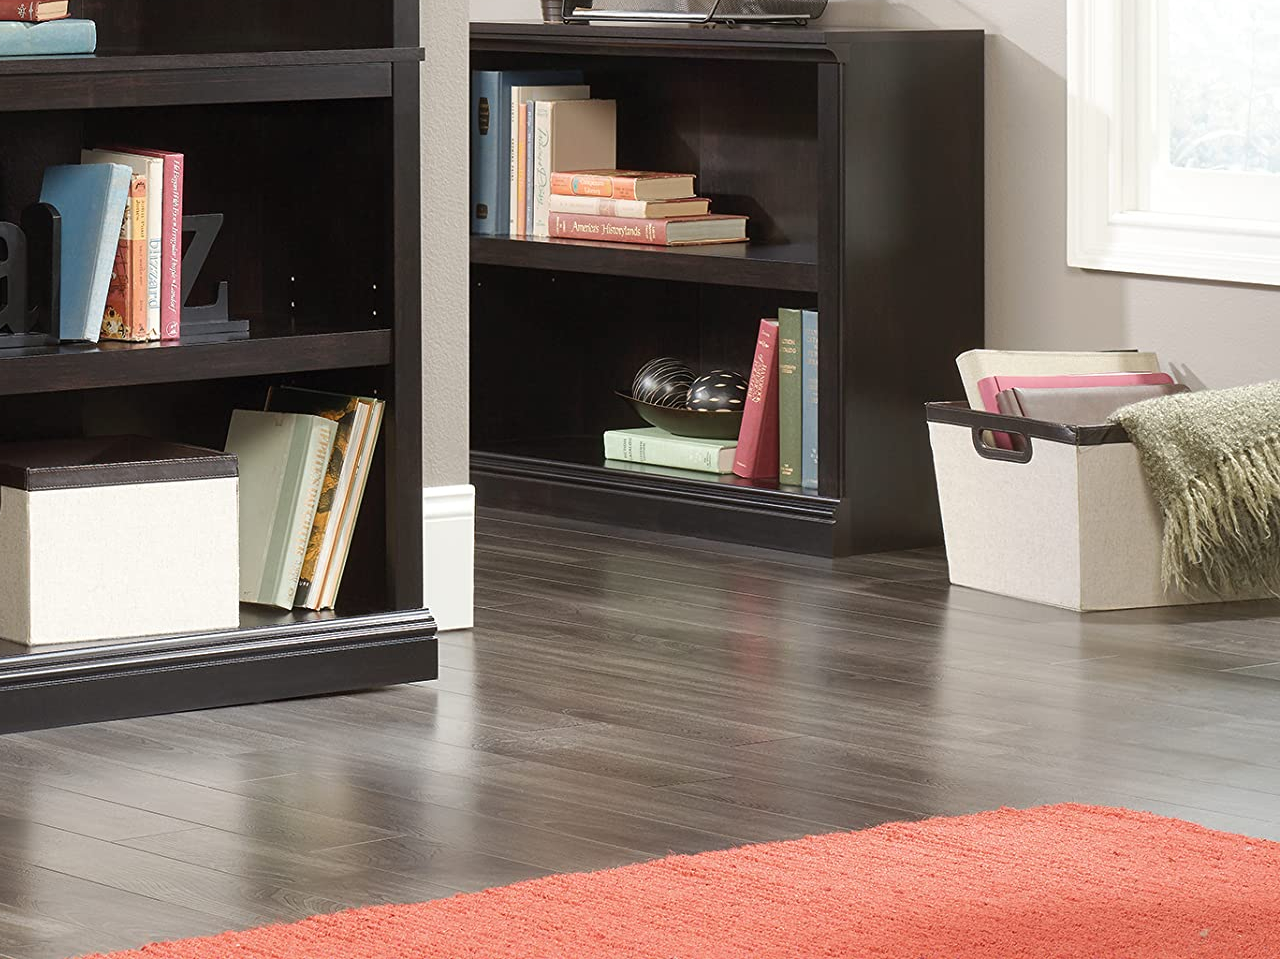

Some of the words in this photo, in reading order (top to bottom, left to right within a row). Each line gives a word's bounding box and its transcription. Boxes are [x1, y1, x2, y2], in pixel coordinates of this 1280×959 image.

[170, 227, 178, 258] Irregular
[573, 221, 600, 234] America's
[601, 220, 641, 237] Historylands
[147, 238, 161, 310] blizzard
[168, 284, 177, 314] Landorf
